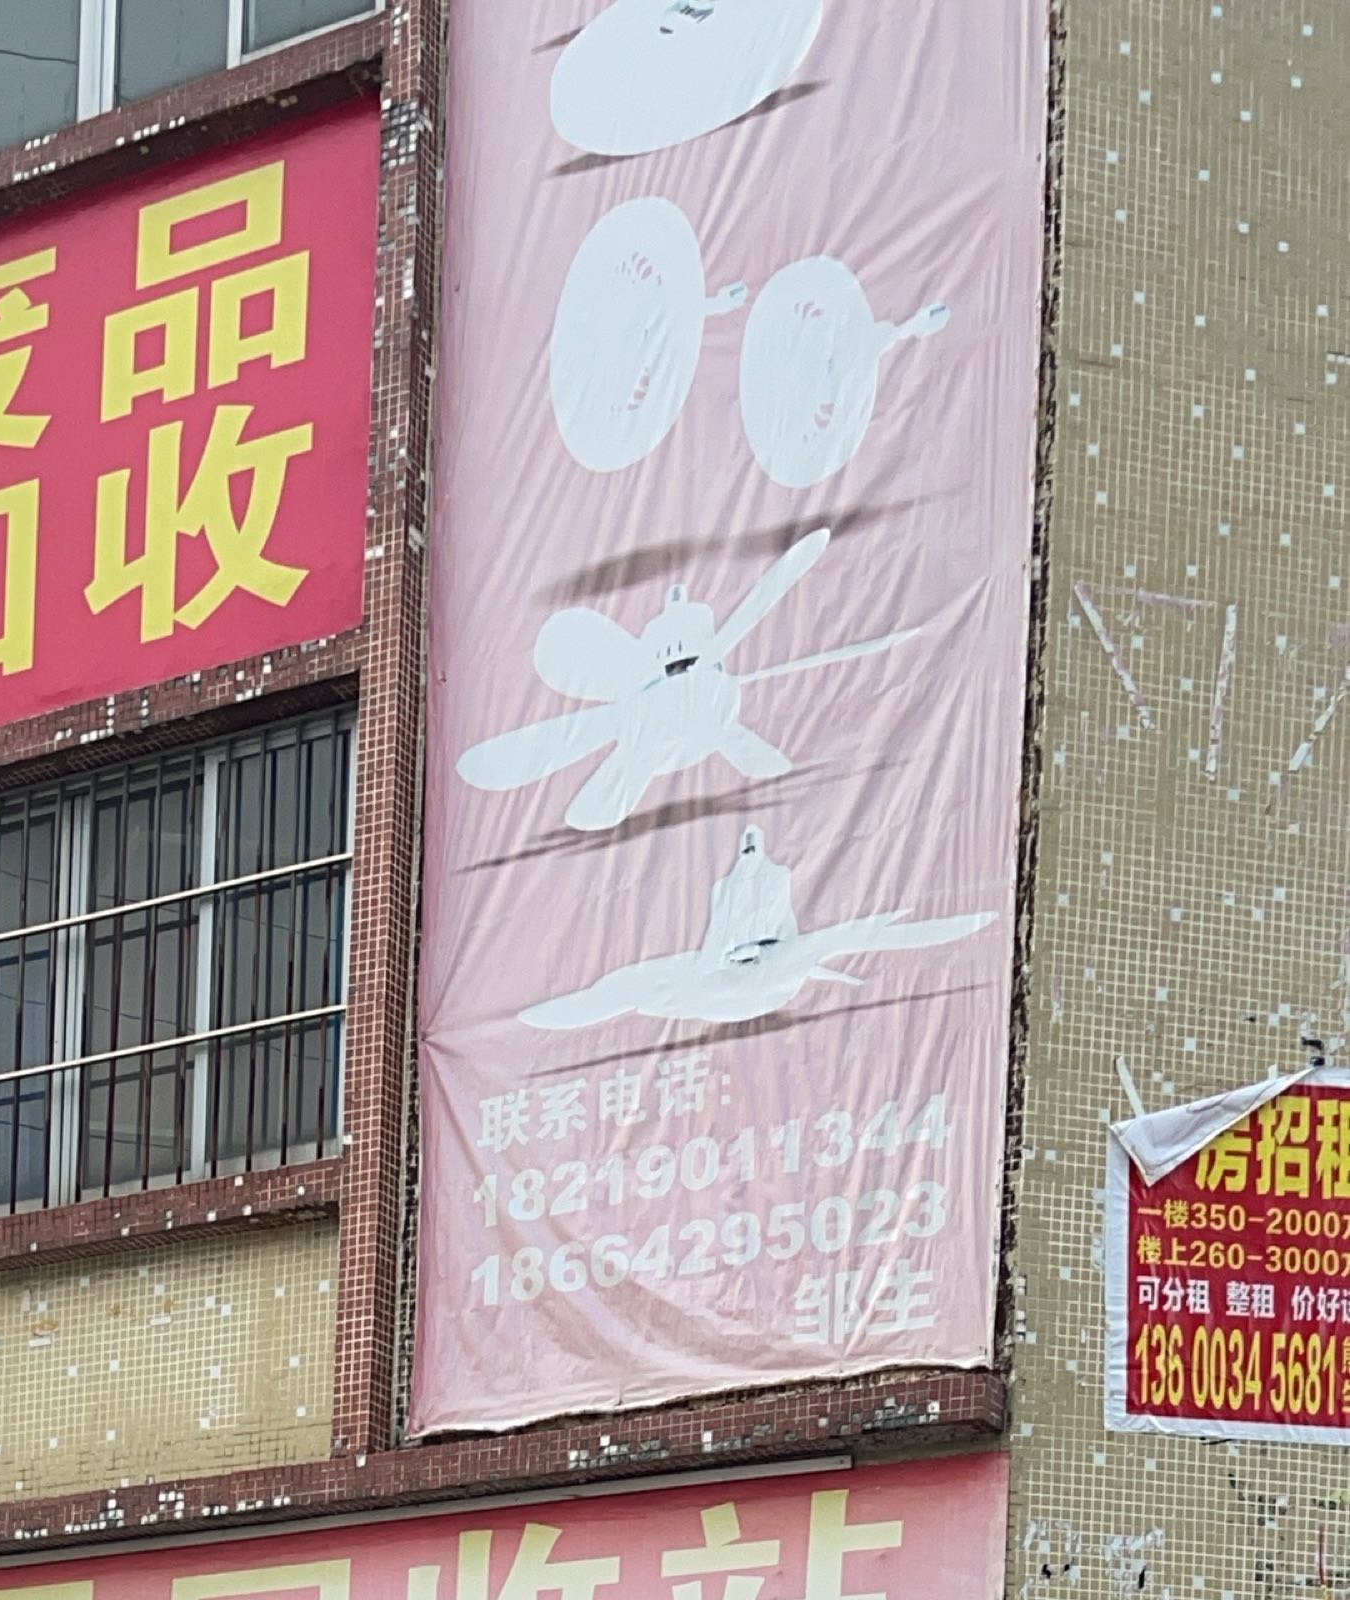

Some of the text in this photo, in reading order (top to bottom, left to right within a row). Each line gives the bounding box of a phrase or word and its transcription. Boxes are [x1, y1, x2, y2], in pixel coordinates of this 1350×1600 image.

[473, 1092, 949, 1229] 18219011344
[471, 1181, 947, 1306] 18664295023
[1137, 1199, 1350, 1239] 一楼350-2000
[1136, 1236, 1350, 1277] 楼上260-3000
[1136, 1276, 1211, 1315] 可分租
[1225, 1280, 1276, 1319] 整租
[1135, 1323, 1185, 1406] 136
[1191, 1325, 1262, 1411] 0034
[1269, 1332, 1337, 1416] 5681
